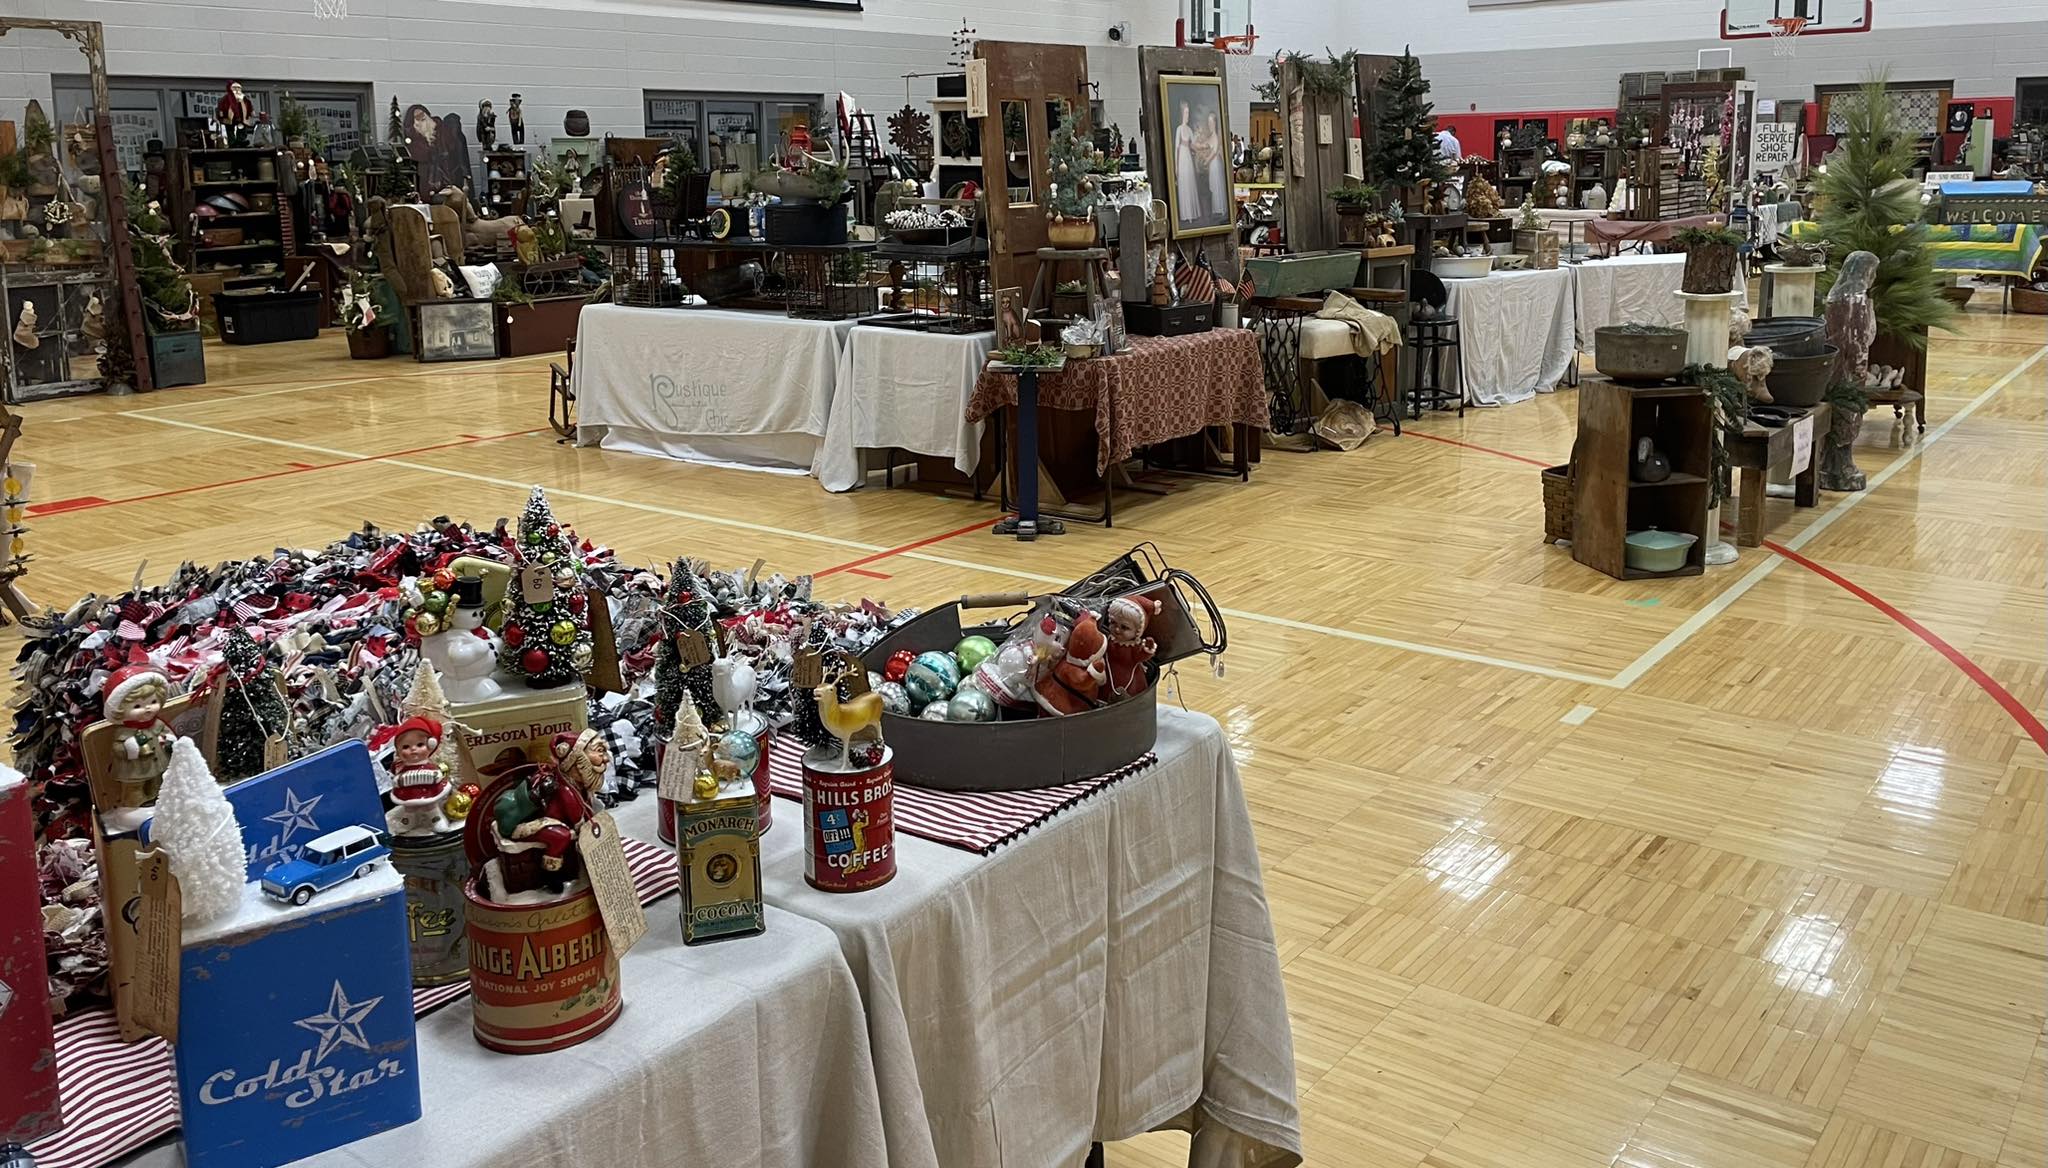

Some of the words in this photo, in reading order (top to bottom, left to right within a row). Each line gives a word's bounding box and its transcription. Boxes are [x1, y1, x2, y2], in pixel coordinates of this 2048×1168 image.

[1757, 133, 1795, 143] SERVICE
[1762, 123, 1788, 133] FULL
[1755, 152, 1789, 162] REPAIR
[1760, 142, 1787, 152] SHOE
[1946, 209, 2041, 223] WELCOME
[649, 373, 728, 429] Rustique
[528, 721, 573, 741] FLOUR
[817, 789, 860, 806] HILLS
[863, 778, 892, 803] BROS
[685, 816, 755, 838] MONARCH
[828, 843, 888, 868] COFFEE
[696, 902, 751, 921] COCOA
[517, 927, 604, 981] ALBERT
[479, 978, 528, 994] NATIONAL
[534, 981, 556, 993] JOY
[560, 966, 597, 988] SMOKE
[200, 1049, 312, 1105] Cold
[285, 1058, 406, 1108] Star
